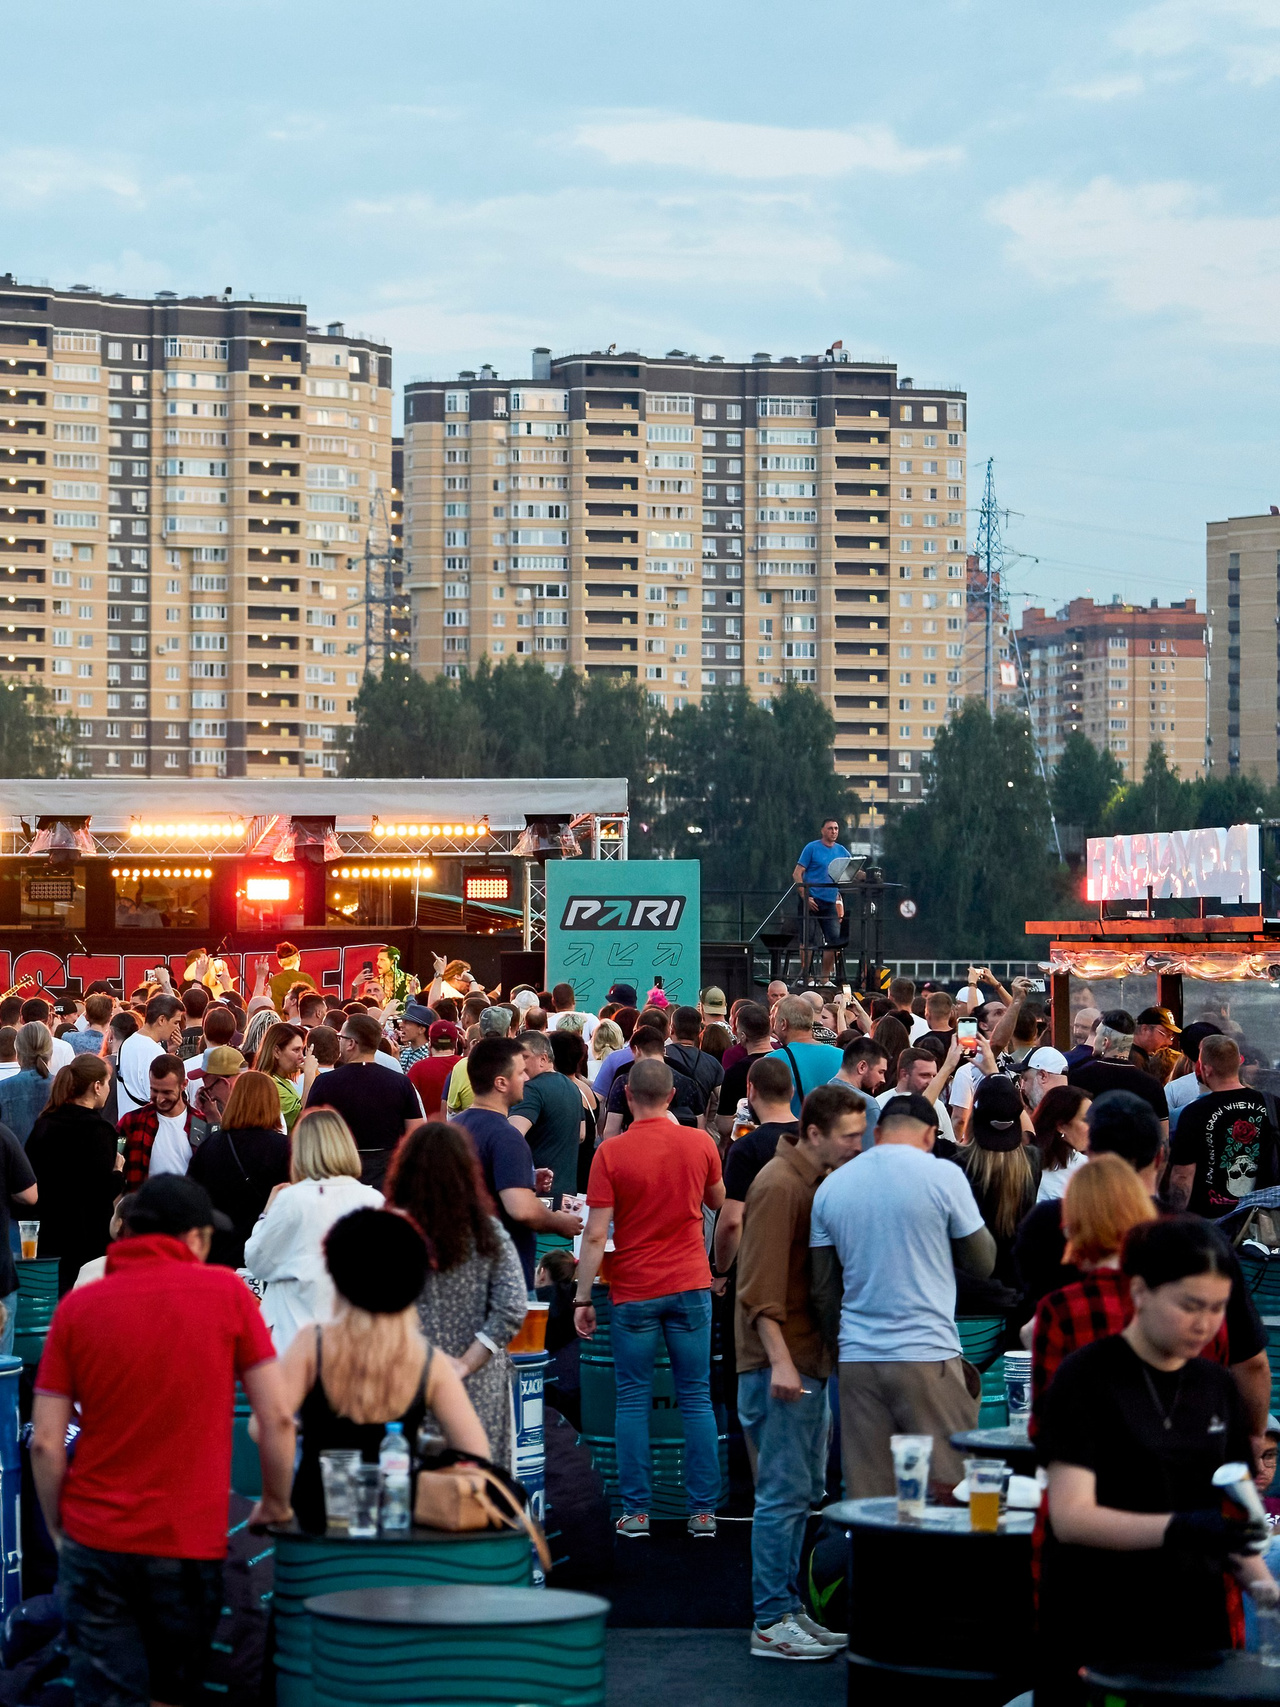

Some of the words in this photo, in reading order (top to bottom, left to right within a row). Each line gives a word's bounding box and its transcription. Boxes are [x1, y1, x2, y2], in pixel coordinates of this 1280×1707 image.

[564, 900, 681, 927] PARI
[1205, 1107, 1224, 1131] GROW
[1223, 1101, 1256, 1112] WHEN
